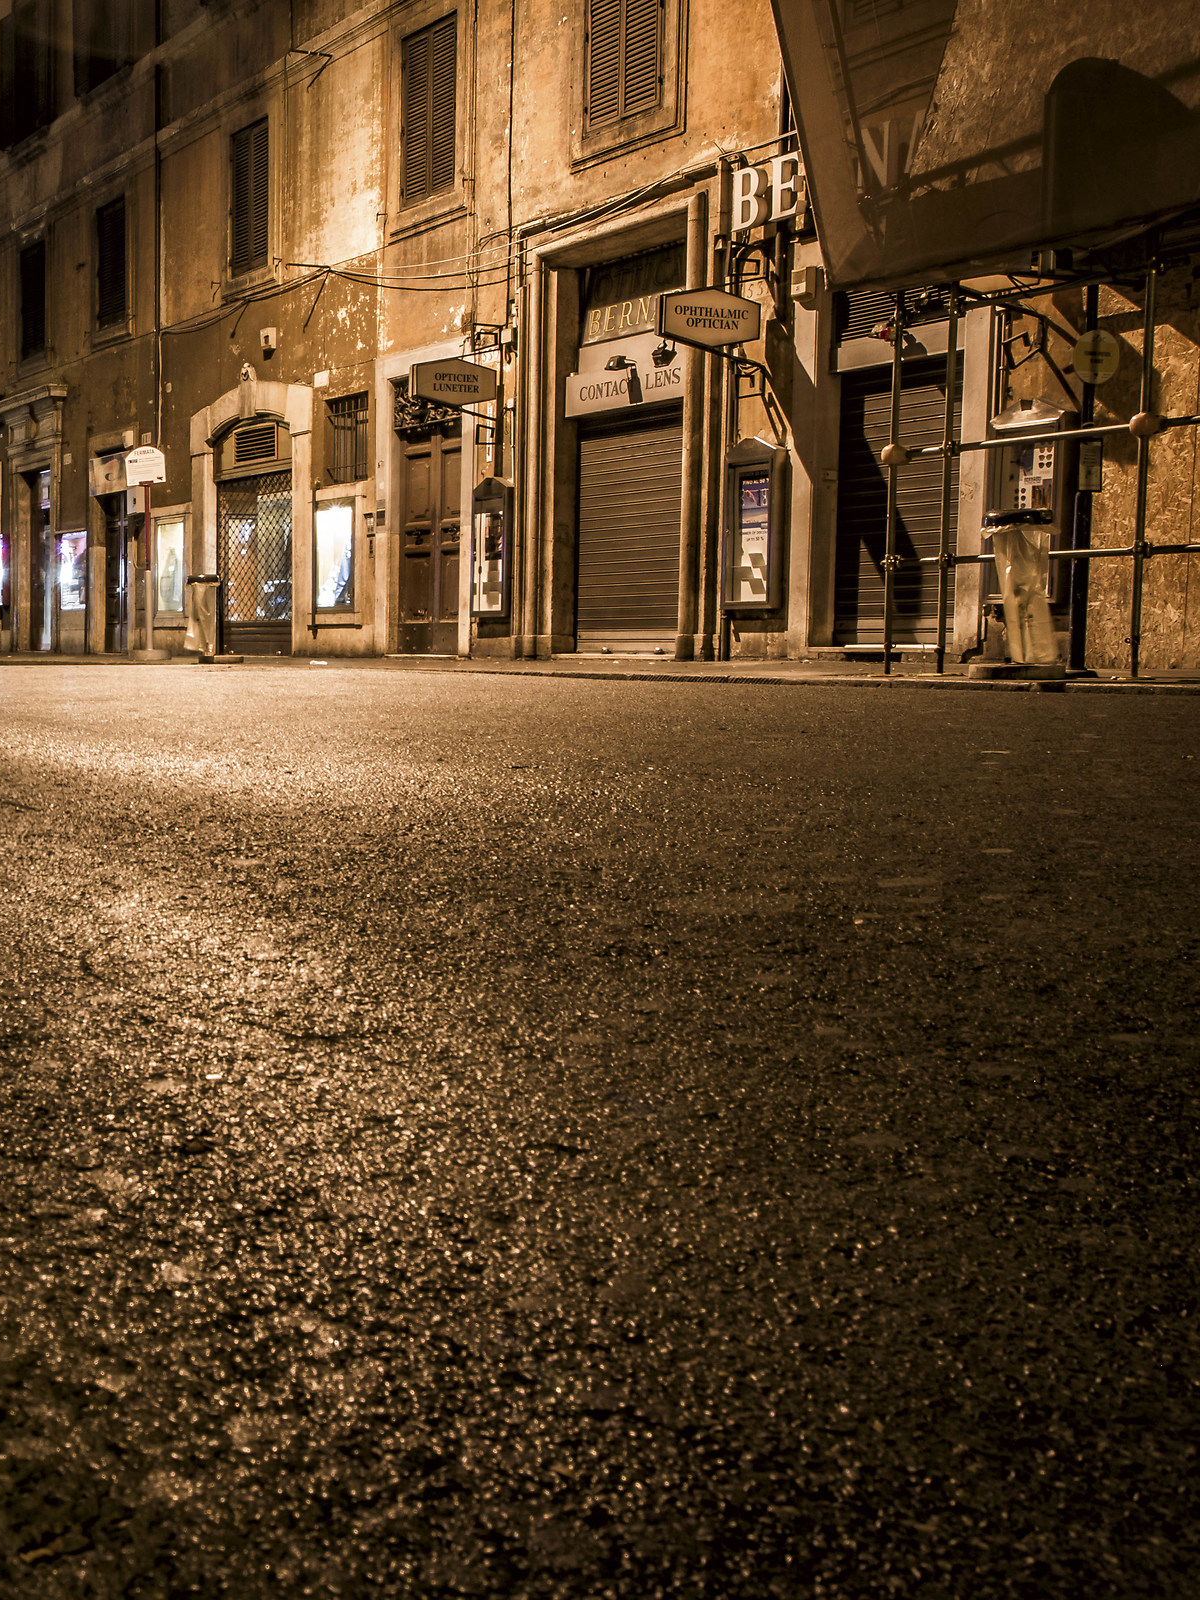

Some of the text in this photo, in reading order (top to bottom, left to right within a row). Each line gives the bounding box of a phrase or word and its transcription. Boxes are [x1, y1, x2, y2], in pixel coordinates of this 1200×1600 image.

[674, 304, 749, 320] OPHTHALMIC
[686, 317, 739, 331] OPTICIAN
[434, 372, 479, 383] OPTICIEN
[580, 367, 681, 402] CONTAC LENS
[433, 382, 480, 394] LUNETIER
